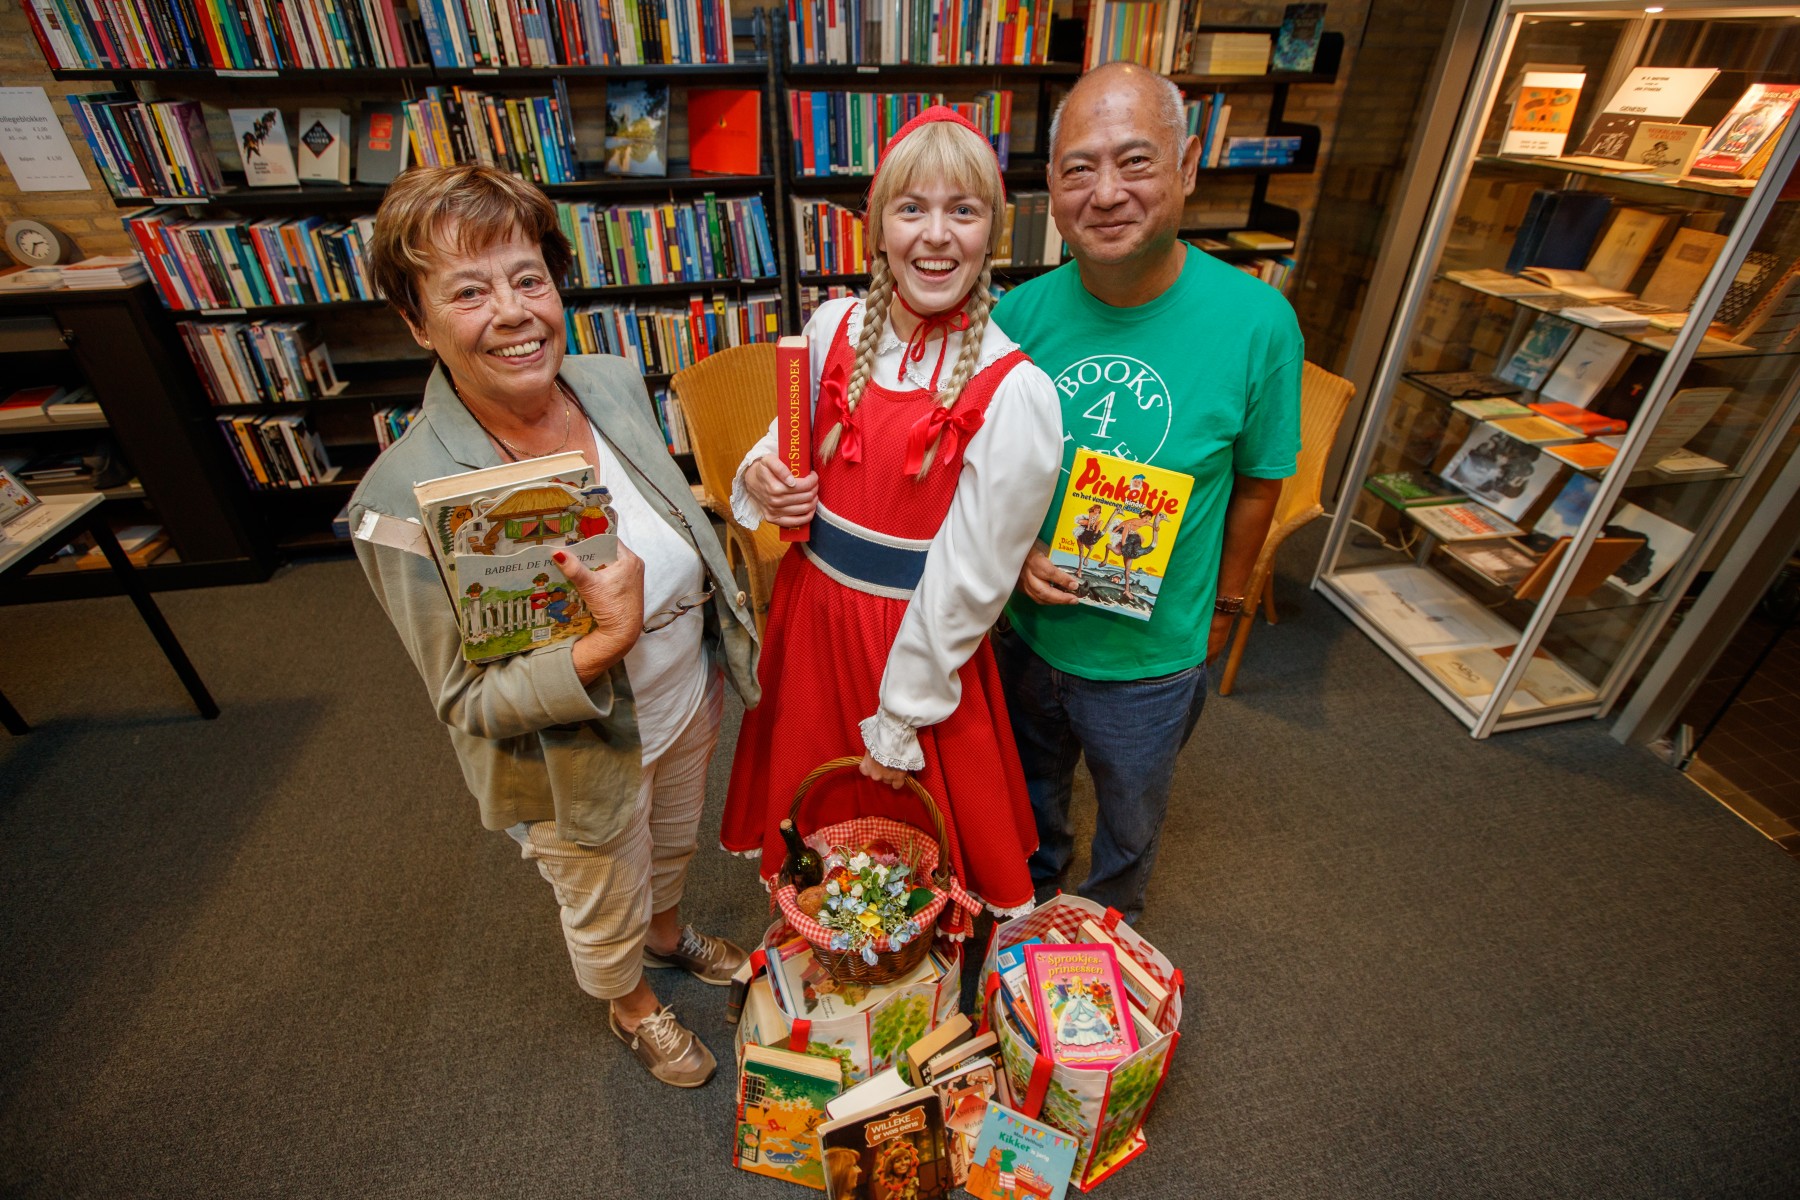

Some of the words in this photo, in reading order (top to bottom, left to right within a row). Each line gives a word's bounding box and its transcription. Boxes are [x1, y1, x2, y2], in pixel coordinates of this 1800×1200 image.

[1056, 361, 1163, 410] BOOKS
[788, 358, 800, 462] SPROOKJESBOEK
[1082, 391, 1116, 438] 4
[1076, 458, 1179, 515] Pinkeltje
[1080, 492, 1092, 501] het
[1124, 498, 1146, 509] kinder
[1058, 543, 1074, 553] Laan
[1061, 538, 1076, 546] Dick
[484, 564, 524, 575] BABBEL
[526, 561, 541, 570] DE
[1048, 953, 1103, 966] Sprookjes-
[1048, 964, 1104, 977] prinsessen
[883, 1128, 899, 1137] was
[900, 1121, 919, 1132] eens
[1014, 1131, 1024, 1139] Max
[999, 1132, 1030, 1152] Kikker
[1036, 1151, 1050, 1162] jarig
